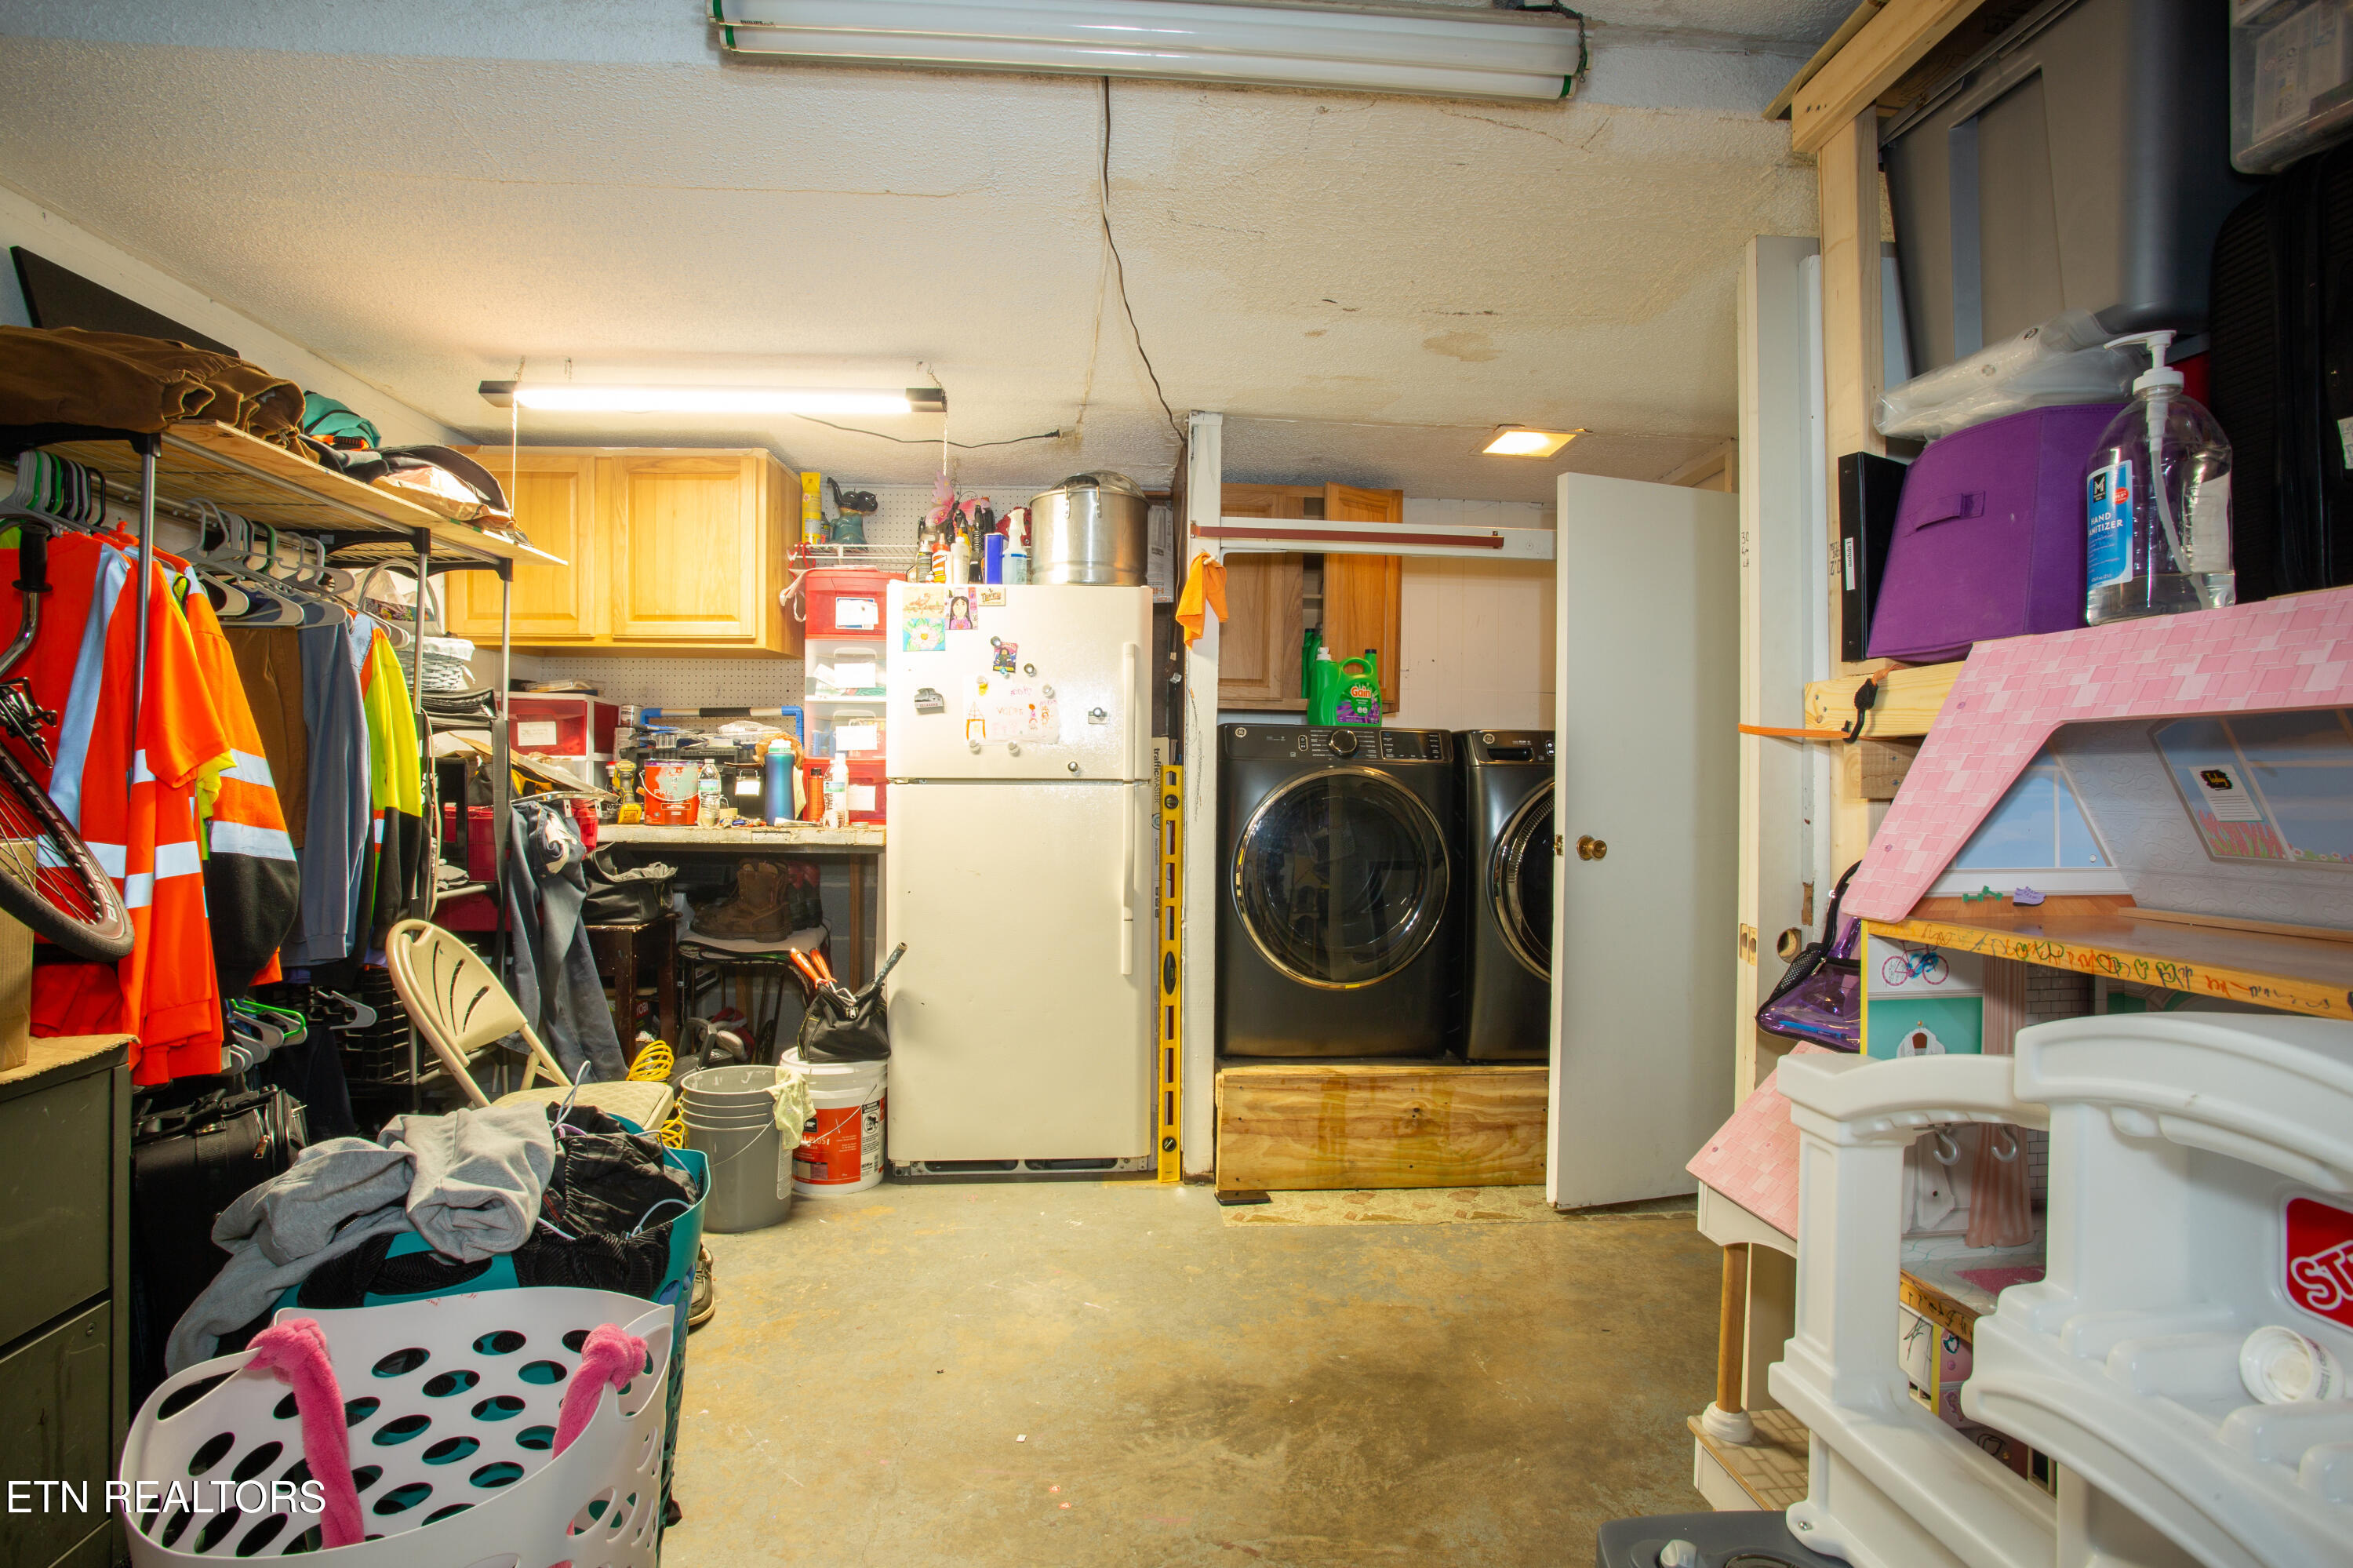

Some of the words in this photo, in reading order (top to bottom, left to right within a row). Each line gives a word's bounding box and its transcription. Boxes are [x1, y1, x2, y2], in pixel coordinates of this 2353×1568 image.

[2091, 511, 2111, 525] HAND
[2089, 519, 2123, 536] ANITIZER
[1351, 686, 1372, 698] Gain
[2206, 773, 2228, 787] Today
[2291, 1240, 2353, 1310] ST
